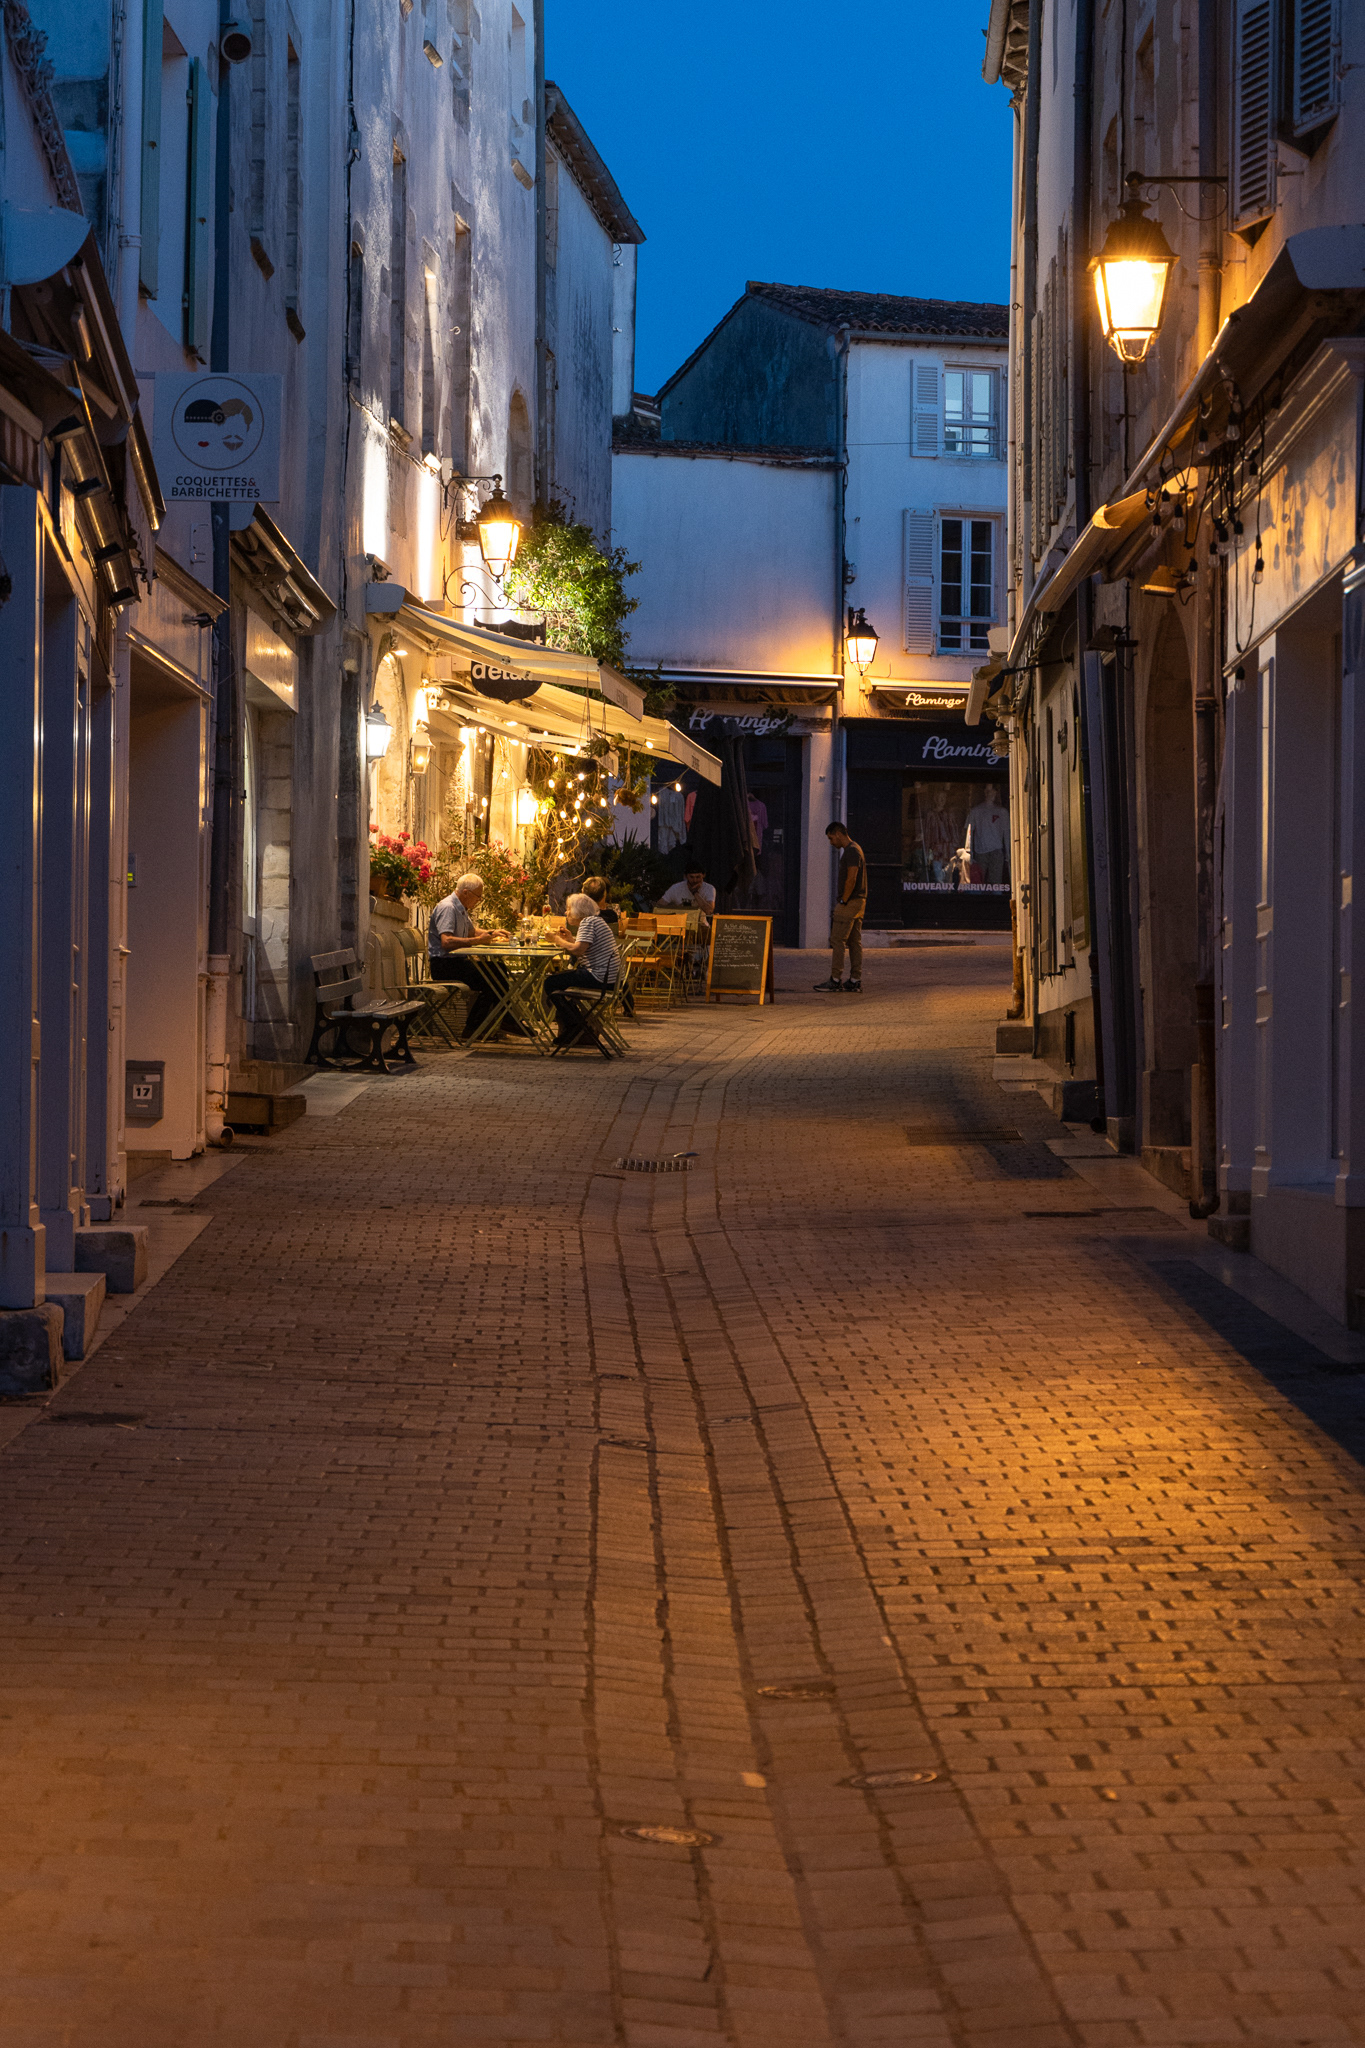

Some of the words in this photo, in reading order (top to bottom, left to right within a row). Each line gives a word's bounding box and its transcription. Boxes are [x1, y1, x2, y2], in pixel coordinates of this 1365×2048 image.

[176, 476, 256, 487] COQUETTES&
[171, 487, 260, 498] BARBICHETTES
[903, 882, 955, 891] NOUVEAUX
[957, 883, 1011, 892] ARRIVAGES
[136, 1087, 150, 1097] 17
